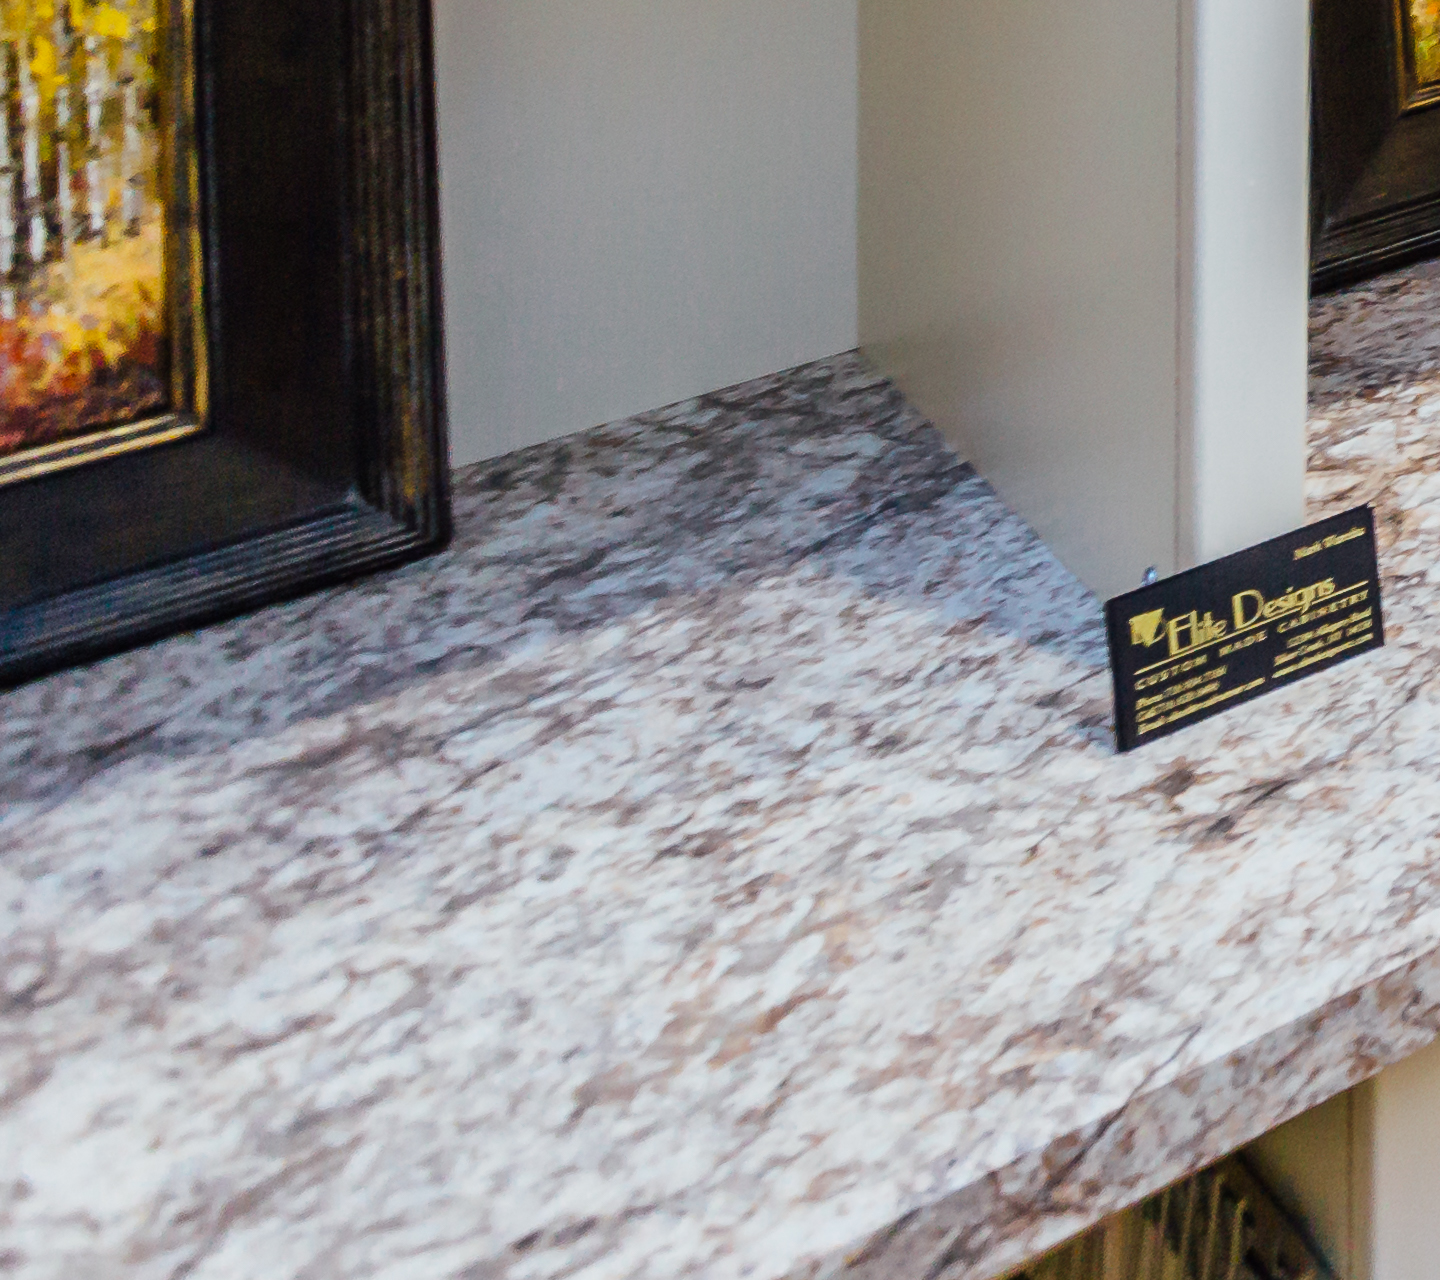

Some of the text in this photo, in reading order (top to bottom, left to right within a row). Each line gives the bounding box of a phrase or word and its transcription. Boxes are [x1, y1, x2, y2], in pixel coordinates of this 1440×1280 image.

[1166, 609, 1228, 657] Elite
[1231, 577, 1336, 630] Designs
[1134, 654, 1208, 691] CUSTOM
[1218, 629, 1268, 658] MADE
